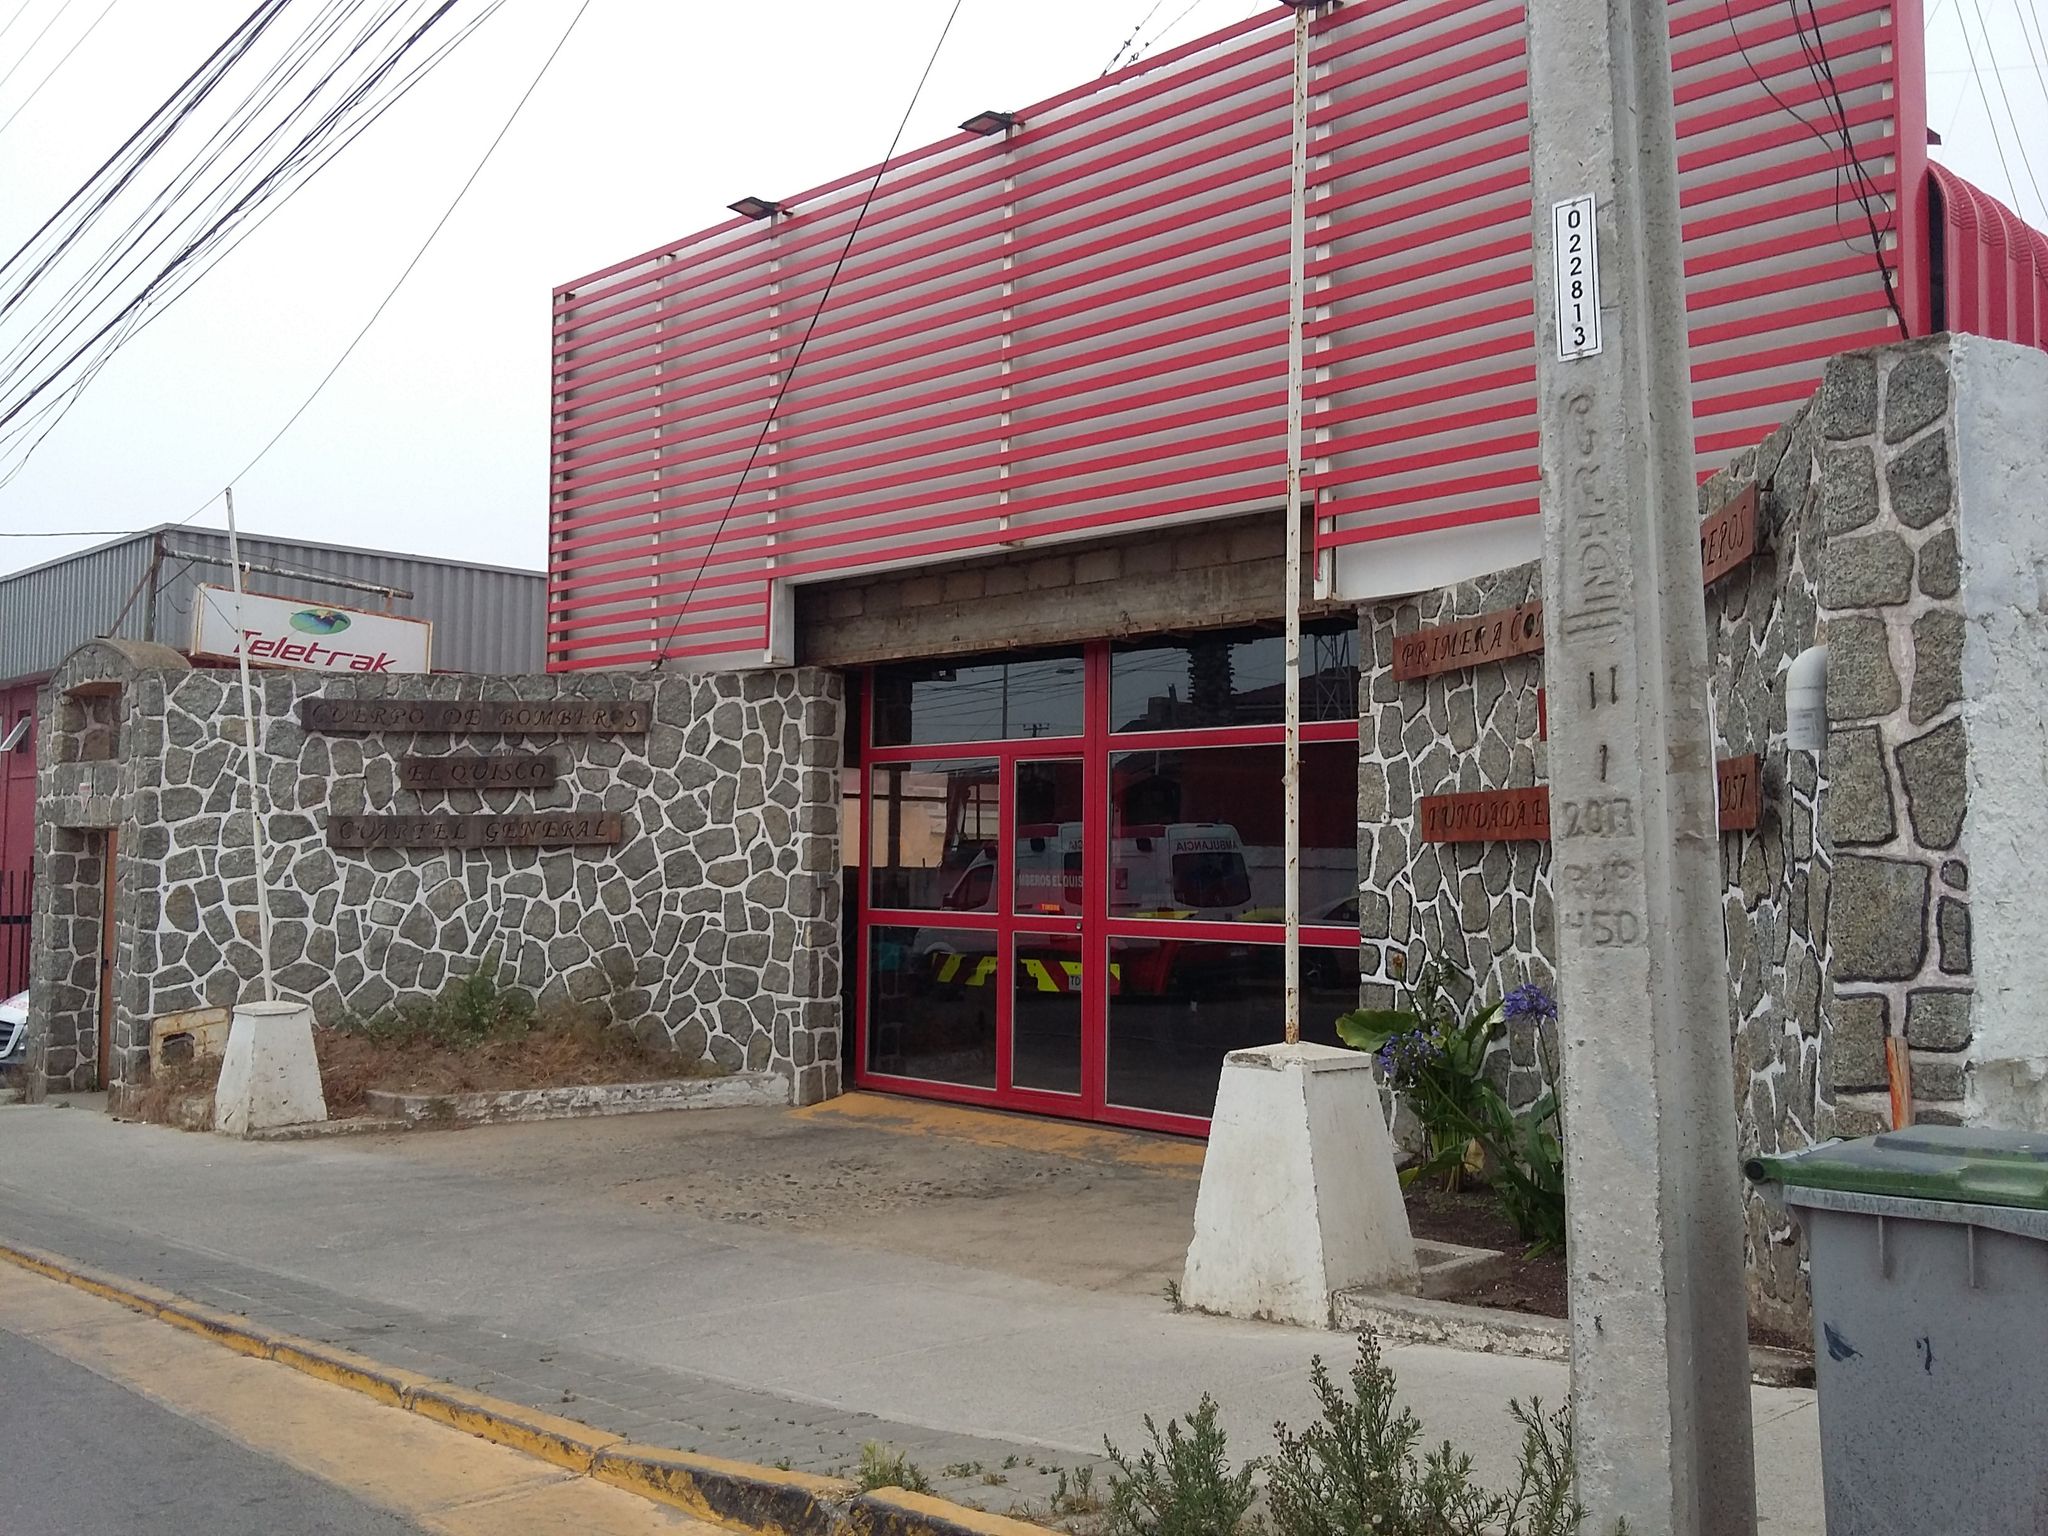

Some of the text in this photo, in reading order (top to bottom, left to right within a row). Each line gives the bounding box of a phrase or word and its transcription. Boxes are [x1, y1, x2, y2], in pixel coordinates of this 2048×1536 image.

[1567, 210, 1586, 346] 022813
[233, 629, 397, 673] Teletrak
[1401, 621, 1503, 668] PRIMERA
[312, 704, 638, 729] CUERPO DE BOMBEROS
[408, 760, 546, 785] EL QUISCO
[340, 818, 607, 843] CUARTEL GENERAL
[1063, 874, 1084, 888] QUIS
